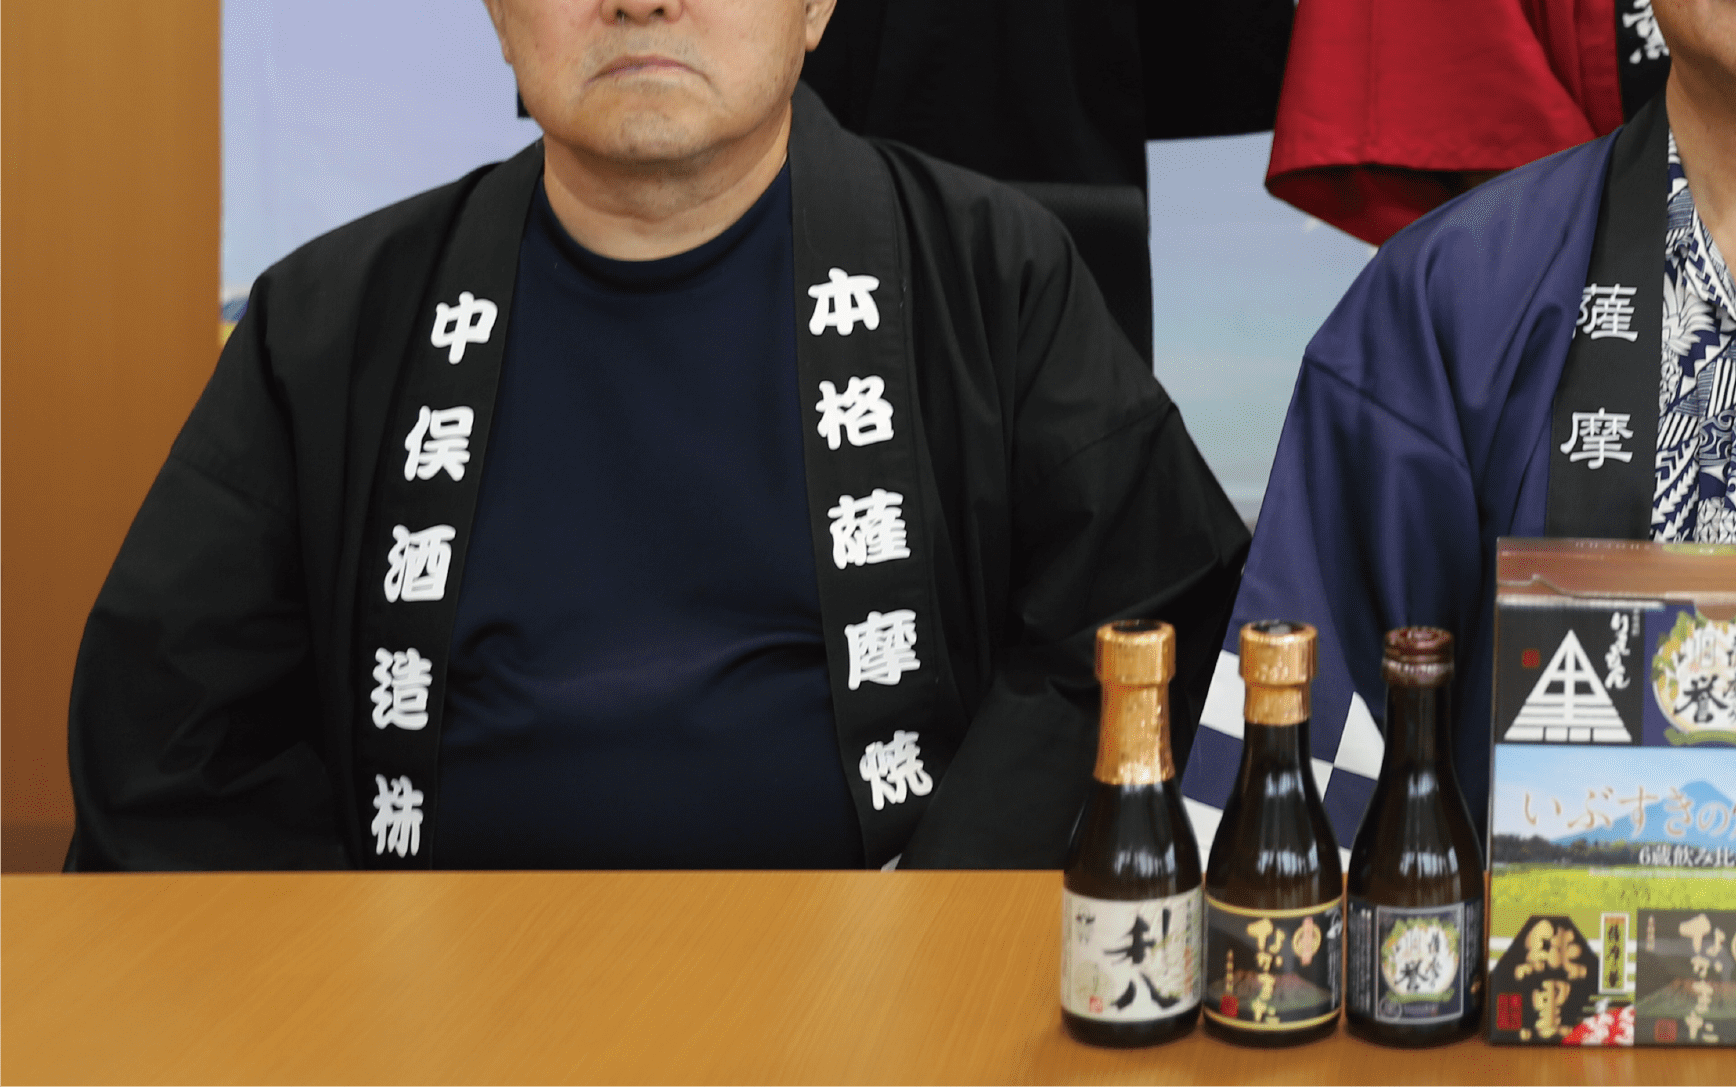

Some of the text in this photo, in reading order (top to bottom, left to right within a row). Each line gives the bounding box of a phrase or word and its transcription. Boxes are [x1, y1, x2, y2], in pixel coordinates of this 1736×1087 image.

[1560, 283, 1639, 470] 薩摩
[371, 291, 498, 857] 中俣酒造株
[808, 268, 932, 872] 本格薩摩焼
[1103, 907, 1181, 1010] 利八
